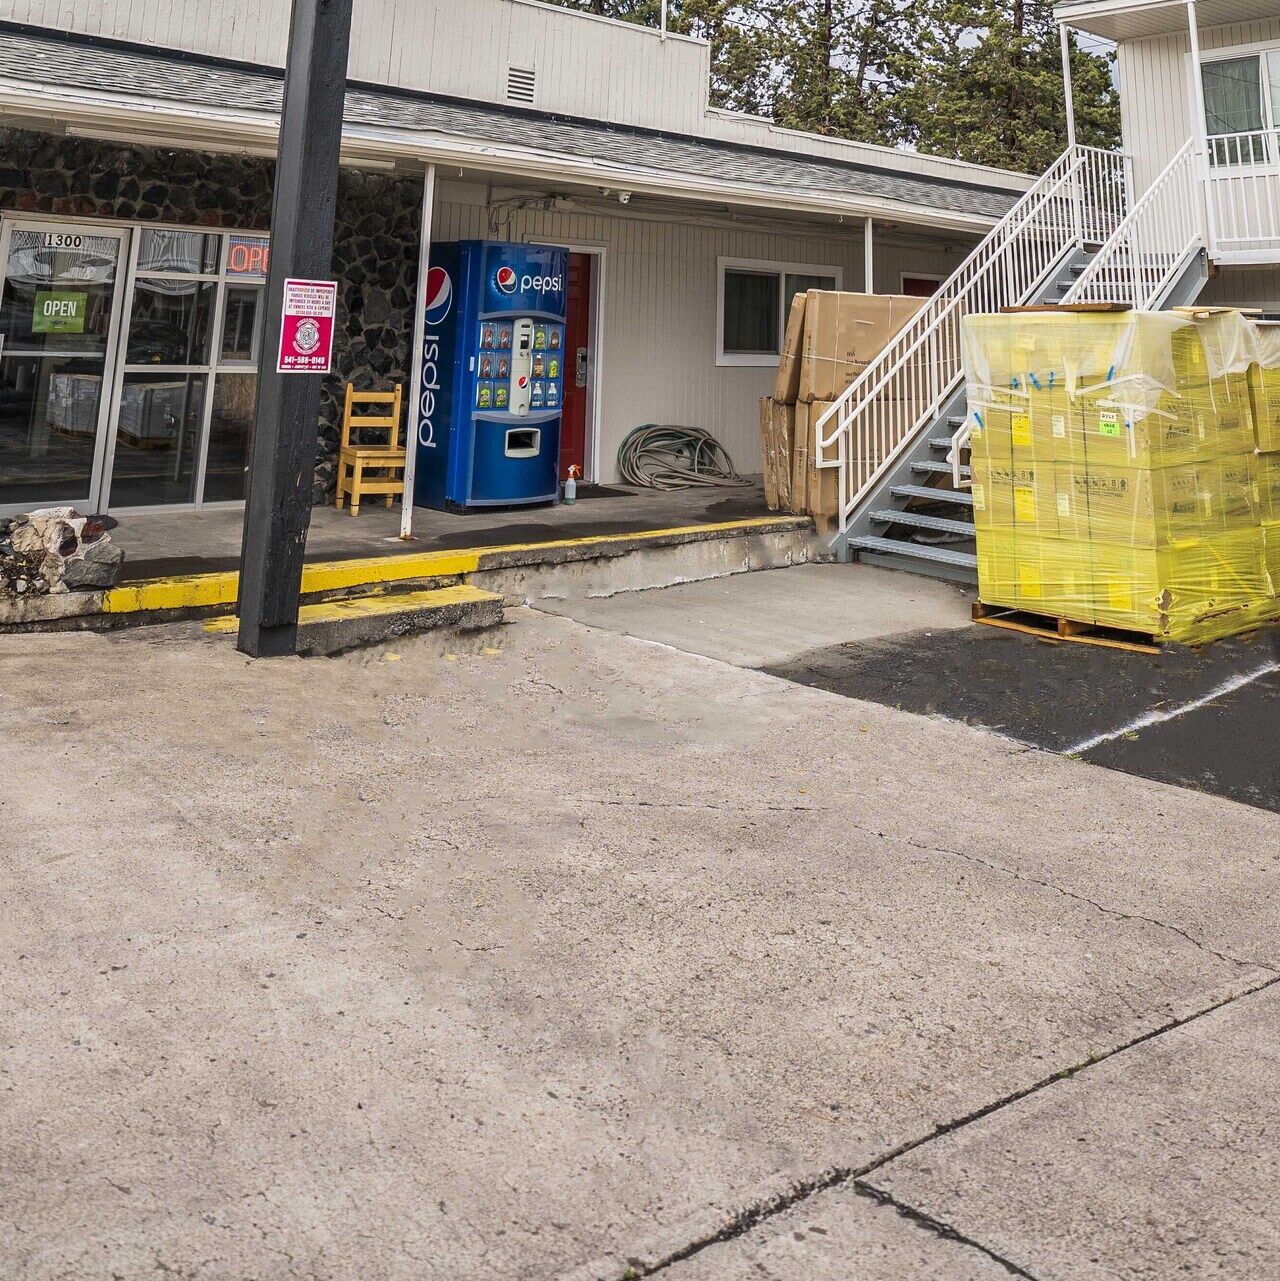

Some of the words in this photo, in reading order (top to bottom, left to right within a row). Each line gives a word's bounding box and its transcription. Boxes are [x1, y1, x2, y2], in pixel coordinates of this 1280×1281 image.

[46, 234, 82, 248] 1300
[231, 245, 270, 272] OPE
[521, 274, 562, 294] pepsi
[43, 300, 77, 316] OPEN
[419, 335, 440, 448] pepsi
